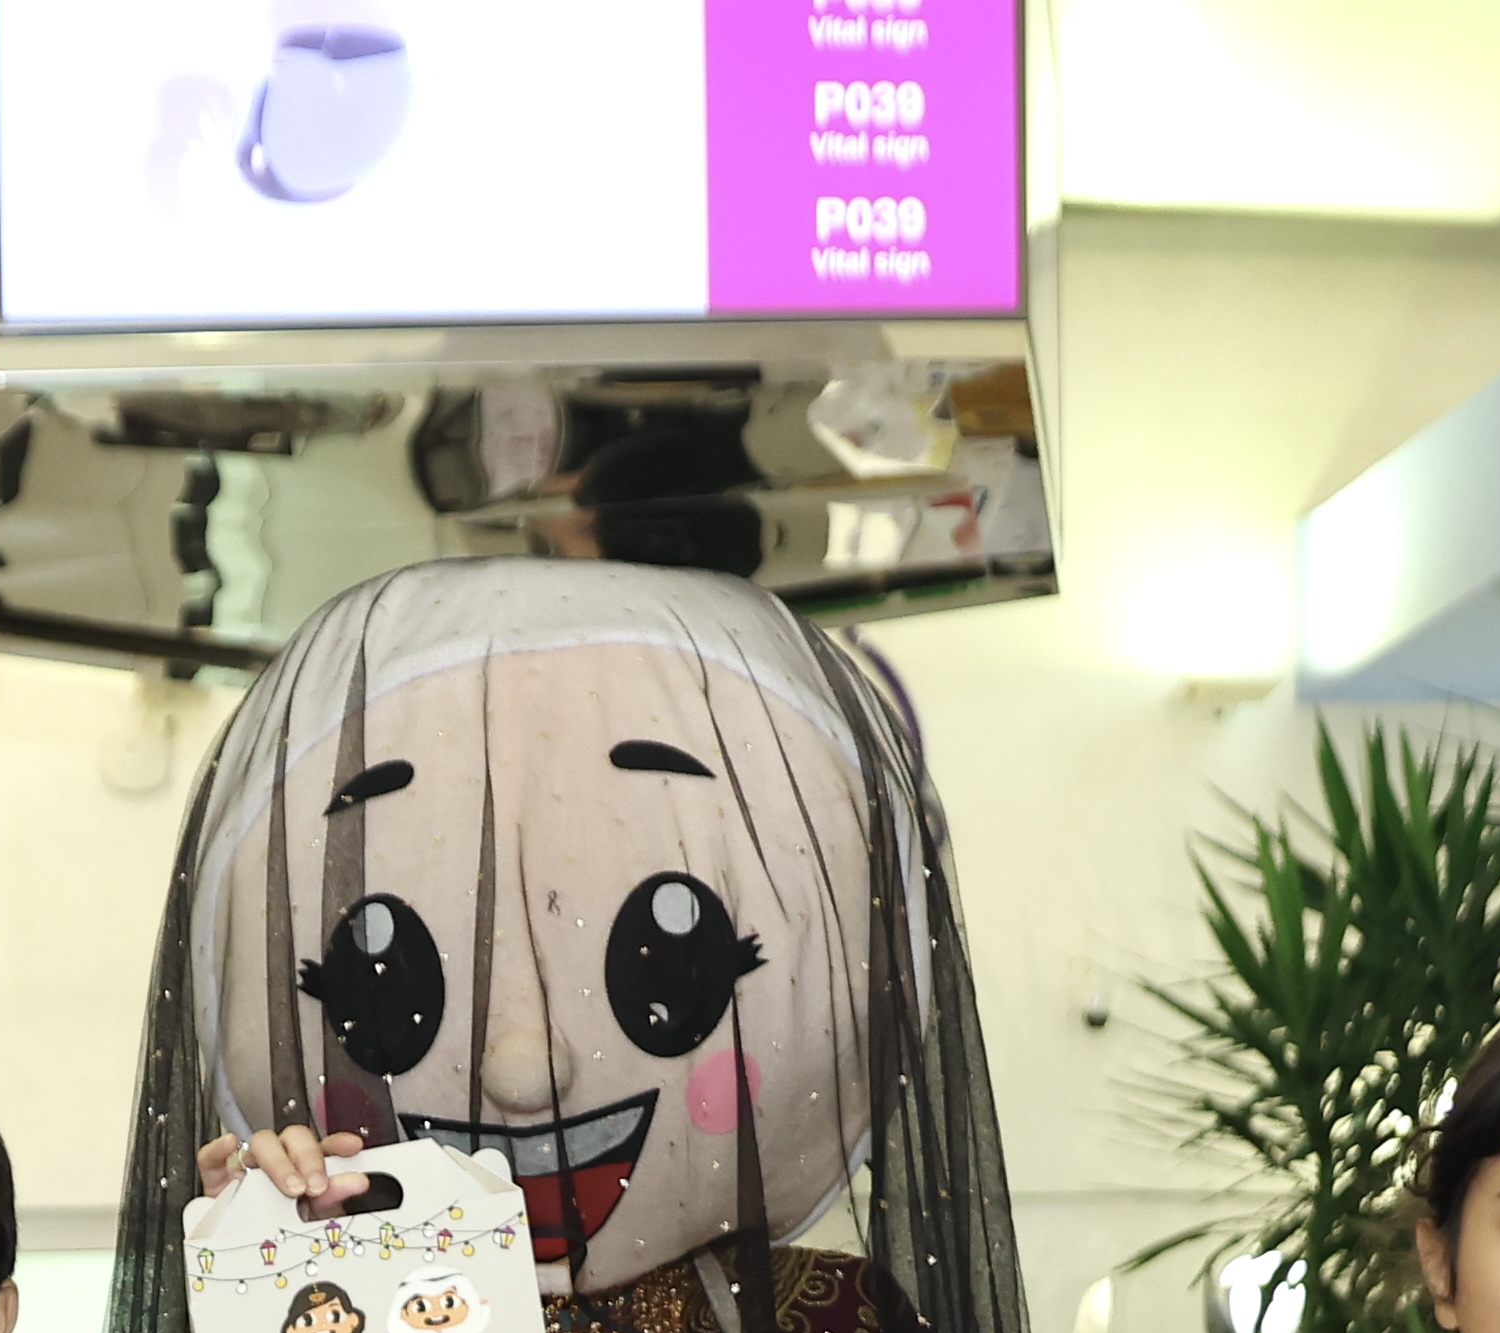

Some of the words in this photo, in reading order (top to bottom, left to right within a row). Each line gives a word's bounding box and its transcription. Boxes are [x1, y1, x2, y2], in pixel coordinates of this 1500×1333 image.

[808, 15, 868, 48] Vital
[871, 15, 928, 52] sign
[814, 80, 925, 128] P039
[809, 131, 869, 165] Vital
[872, 131, 930, 169] sign
[815, 196, 926, 242] P039
[811, 247, 870, 280] Vital
[873, 247, 931, 284] sign
